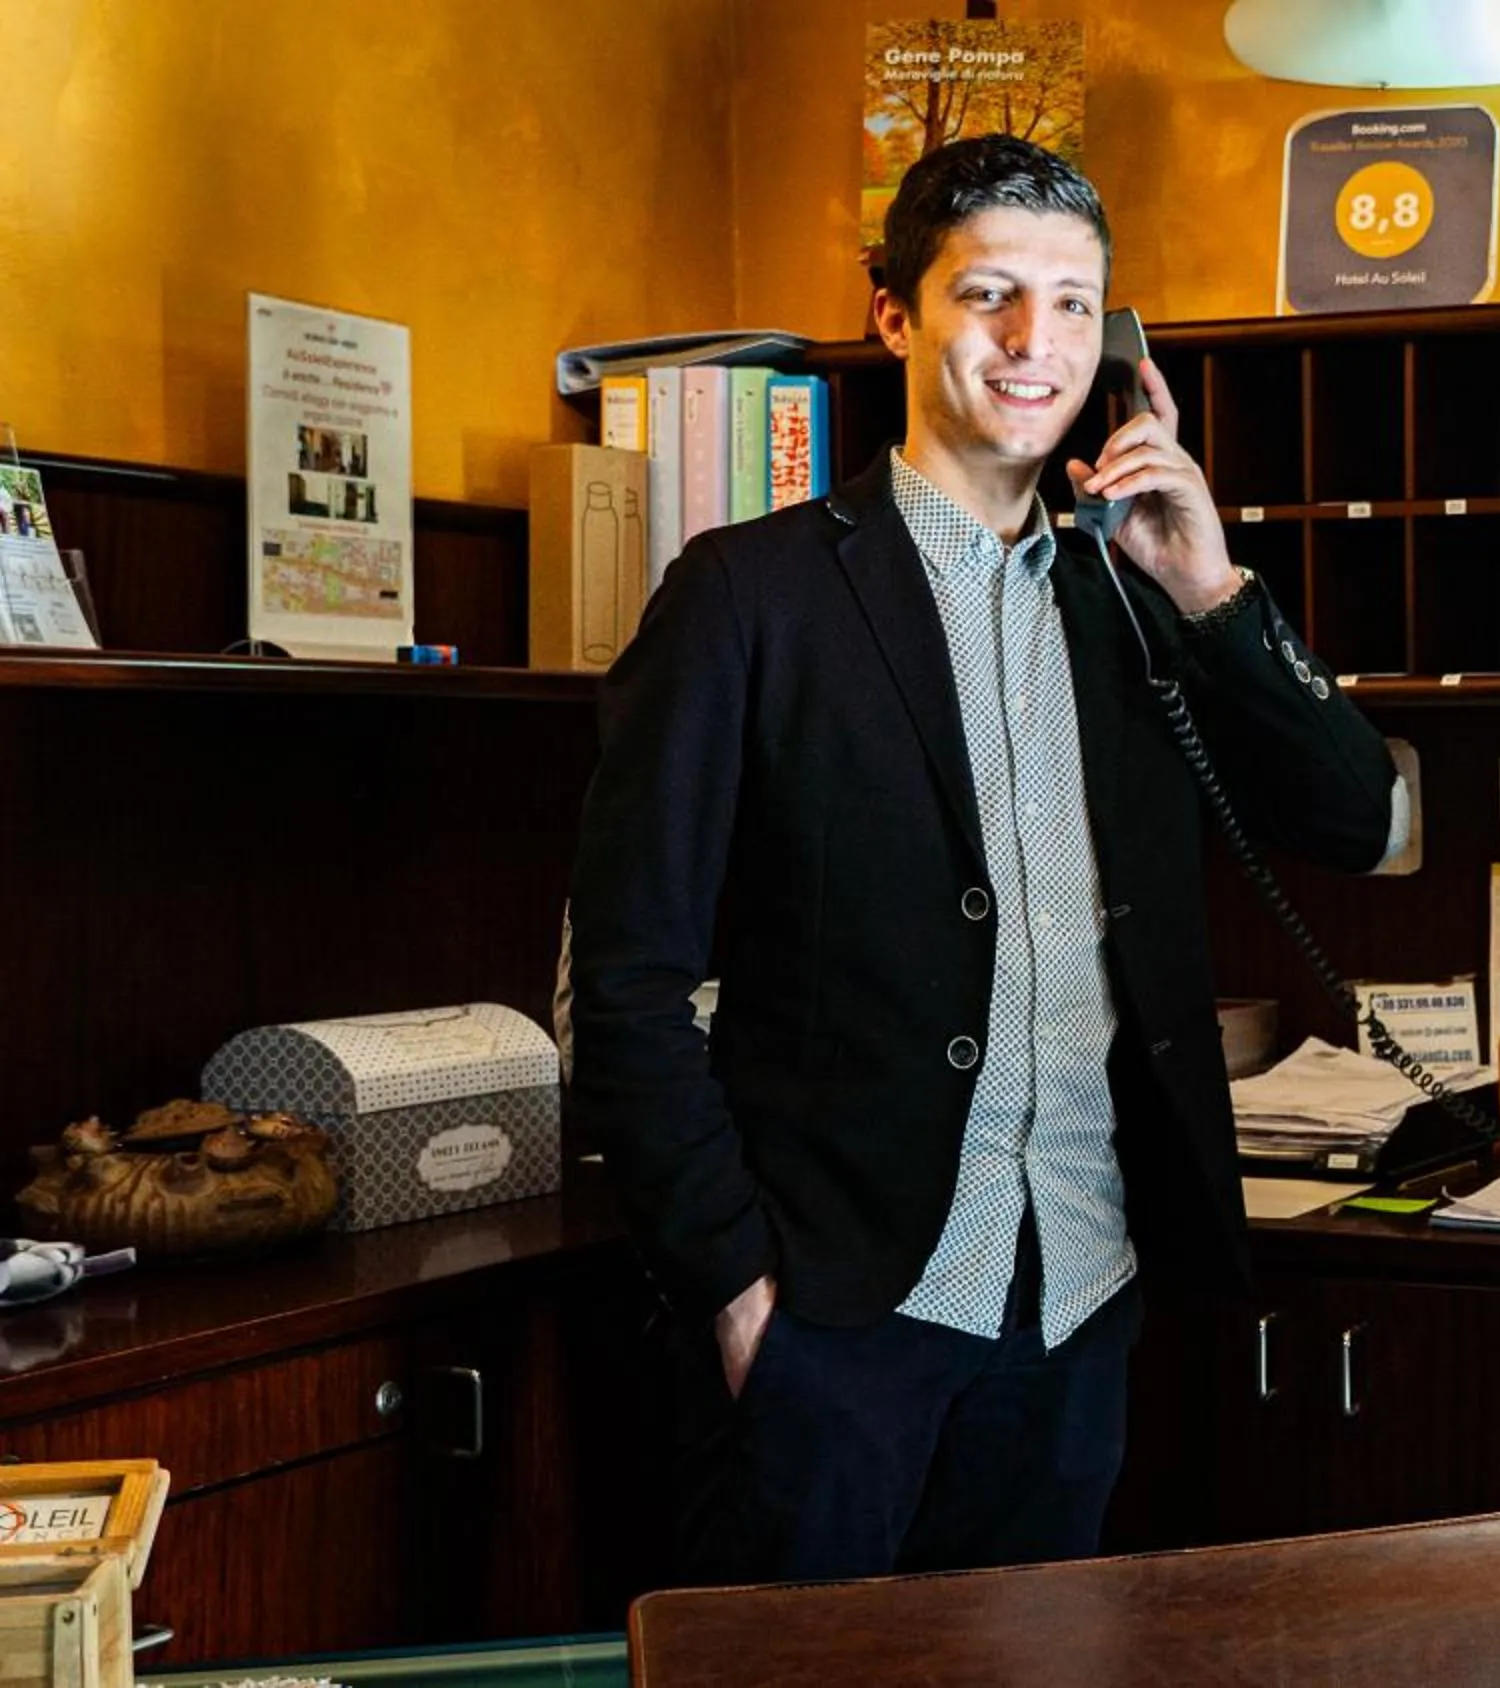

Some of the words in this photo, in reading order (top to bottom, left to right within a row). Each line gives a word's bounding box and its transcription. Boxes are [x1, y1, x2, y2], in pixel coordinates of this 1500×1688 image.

[884, 48, 941, 64] Gene
[948, 48, 1024, 67] Pompa
[1351, 123, 1427, 135] Booking.com
[1350, 191, 1420, 234] 8,8
[1335, 273, 1369, 285] Hotel
[1371, 272, 1389, 284] Au
[1391, 271, 1426, 284] Soleil
